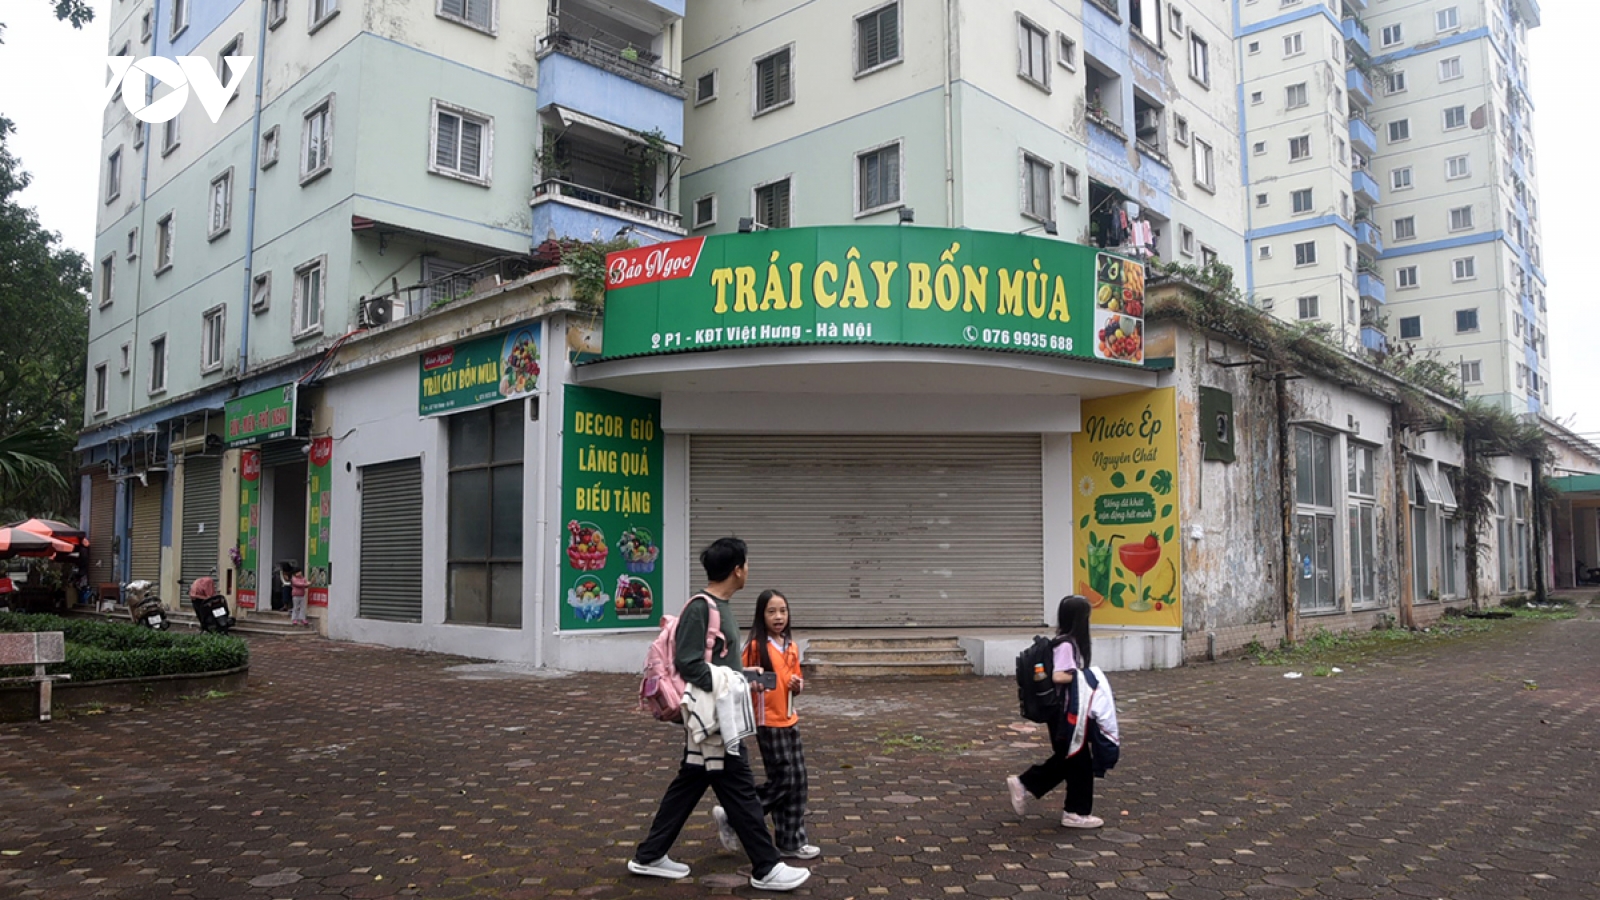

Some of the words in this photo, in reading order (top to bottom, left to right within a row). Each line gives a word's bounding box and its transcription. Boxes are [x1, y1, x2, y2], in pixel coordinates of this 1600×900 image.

[608, 257, 642, 285] Bảo
[645, 247, 691, 278] Ngọc
[711, 250, 804, 314] TRÁI
[812, 247, 898, 309] CÂY
[907, 241, 989, 314] BỐN
[997, 258, 1071, 323] MÙA
[664, 332, 681, 347] P1
[695, 328, 723, 344] KĐT
[726, 326, 757, 343] Việt
[760, 324, 801, 340] Hưng
[816, 322, 837, 338] Hà
[842, 322, 872, 341] Nội
[982, 328, 1010, 344] 076
[1013, 331, 1047, 348] 9935
[1050, 335, 1073, 351] 688
[575, 411, 623, 438] DECOR
[630, 413, 653, 441] GIỎ
[1086, 415, 1135, 443] Nước
[1139, 403, 1162, 445] Ép
[621, 446, 649, 477] QUẢ
[575, 481, 610, 512] BIẾU
[613, 485, 651, 518] TẶNG
